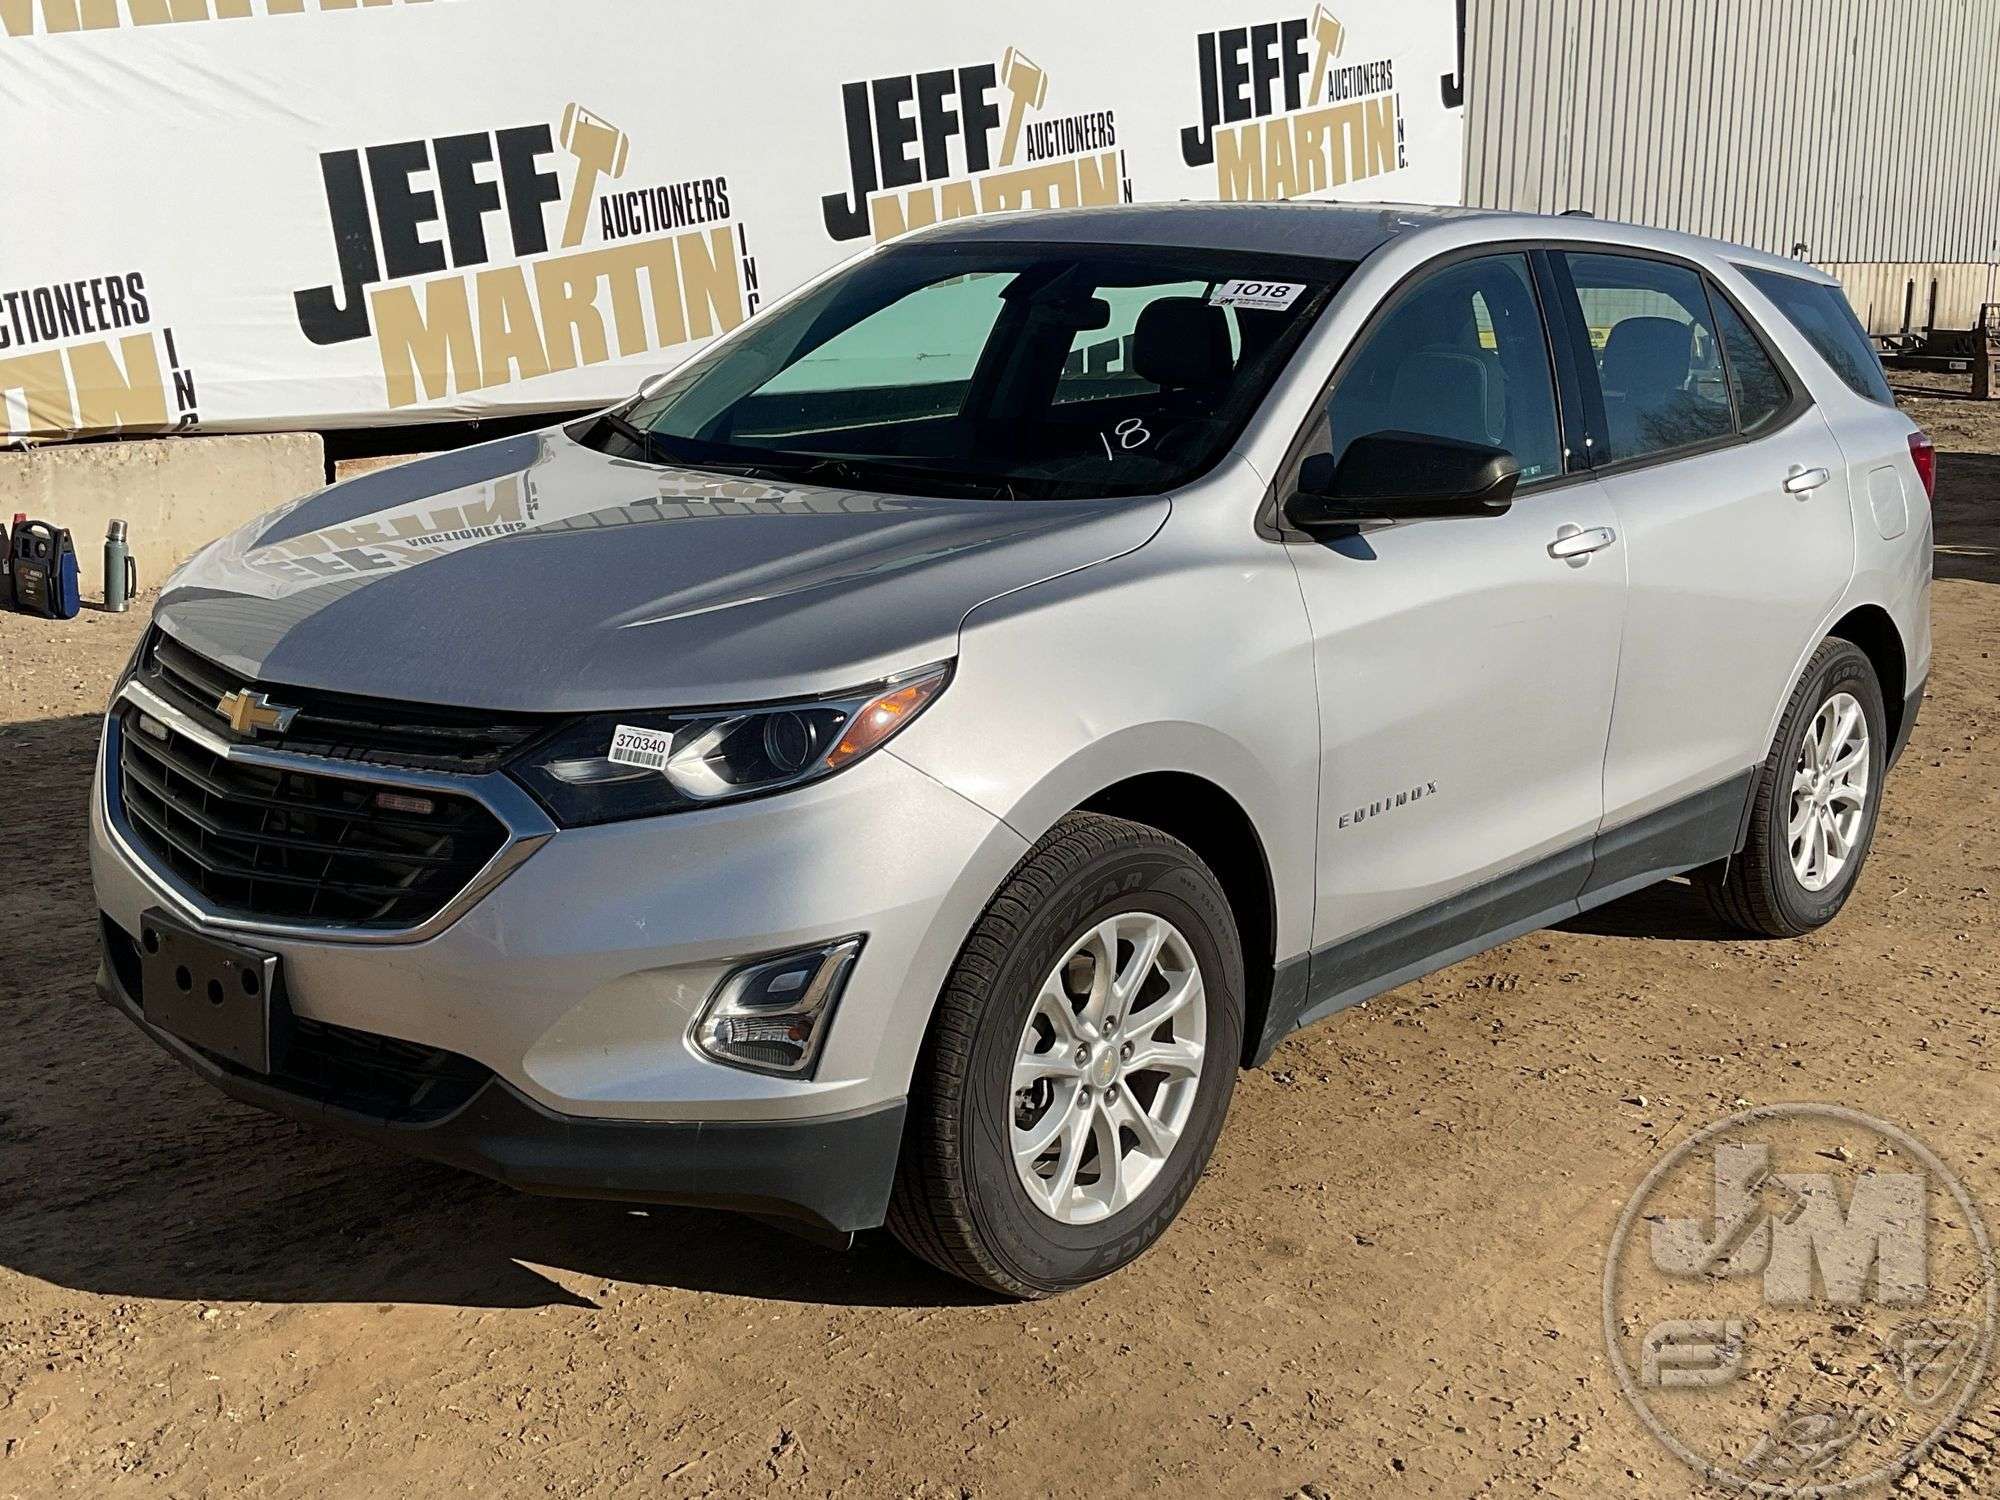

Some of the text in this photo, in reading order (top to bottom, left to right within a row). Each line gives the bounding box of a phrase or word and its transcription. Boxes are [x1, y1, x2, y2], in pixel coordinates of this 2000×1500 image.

[1180, 18, 1309, 168] JEFF
[1327, 58, 1393, 103] AUCTIONEERS
[821, 62, 1001, 241] JEFF
[1026, 110, 1116, 162] AUCTIONEERS
[1215, 95, 1396, 201] MARTIN
[293, 123, 562, 346] JEFF
[600, 176, 731, 241] AUCTIONEERS
[370, 225, 744, 409] MARTIN
[1232, 282, 1291, 298] 1018
[1100, 418, 1151, 461] 18
[616, 733, 666, 754] 370340
[1338, 780, 1438, 829] EQUINOX
